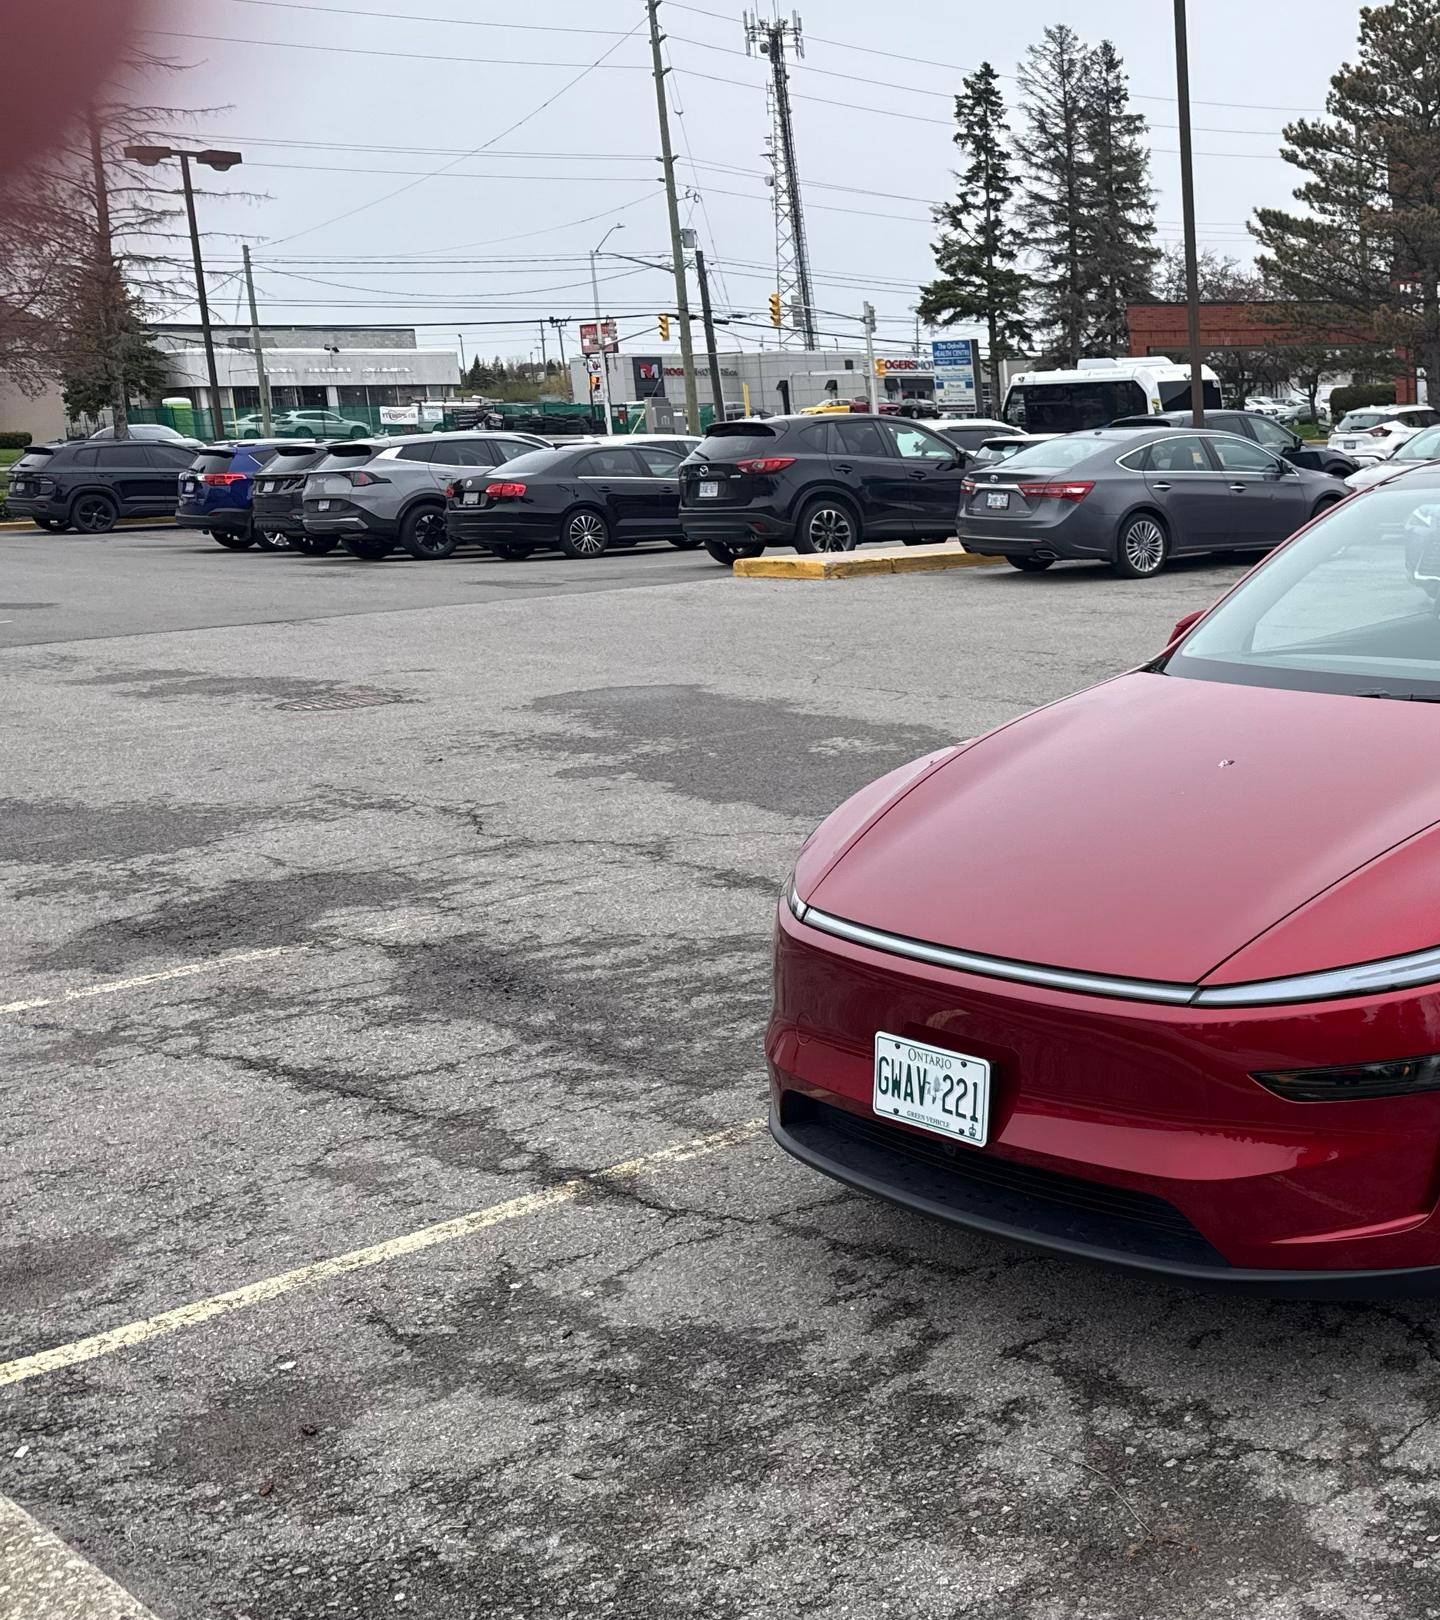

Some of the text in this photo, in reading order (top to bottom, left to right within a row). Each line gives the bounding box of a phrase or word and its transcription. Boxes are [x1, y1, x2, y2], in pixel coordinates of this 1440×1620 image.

[907, 1047, 952, 1071] ONTARIO
[906, 1109, 951, 1128] GREEN VEHICLE
